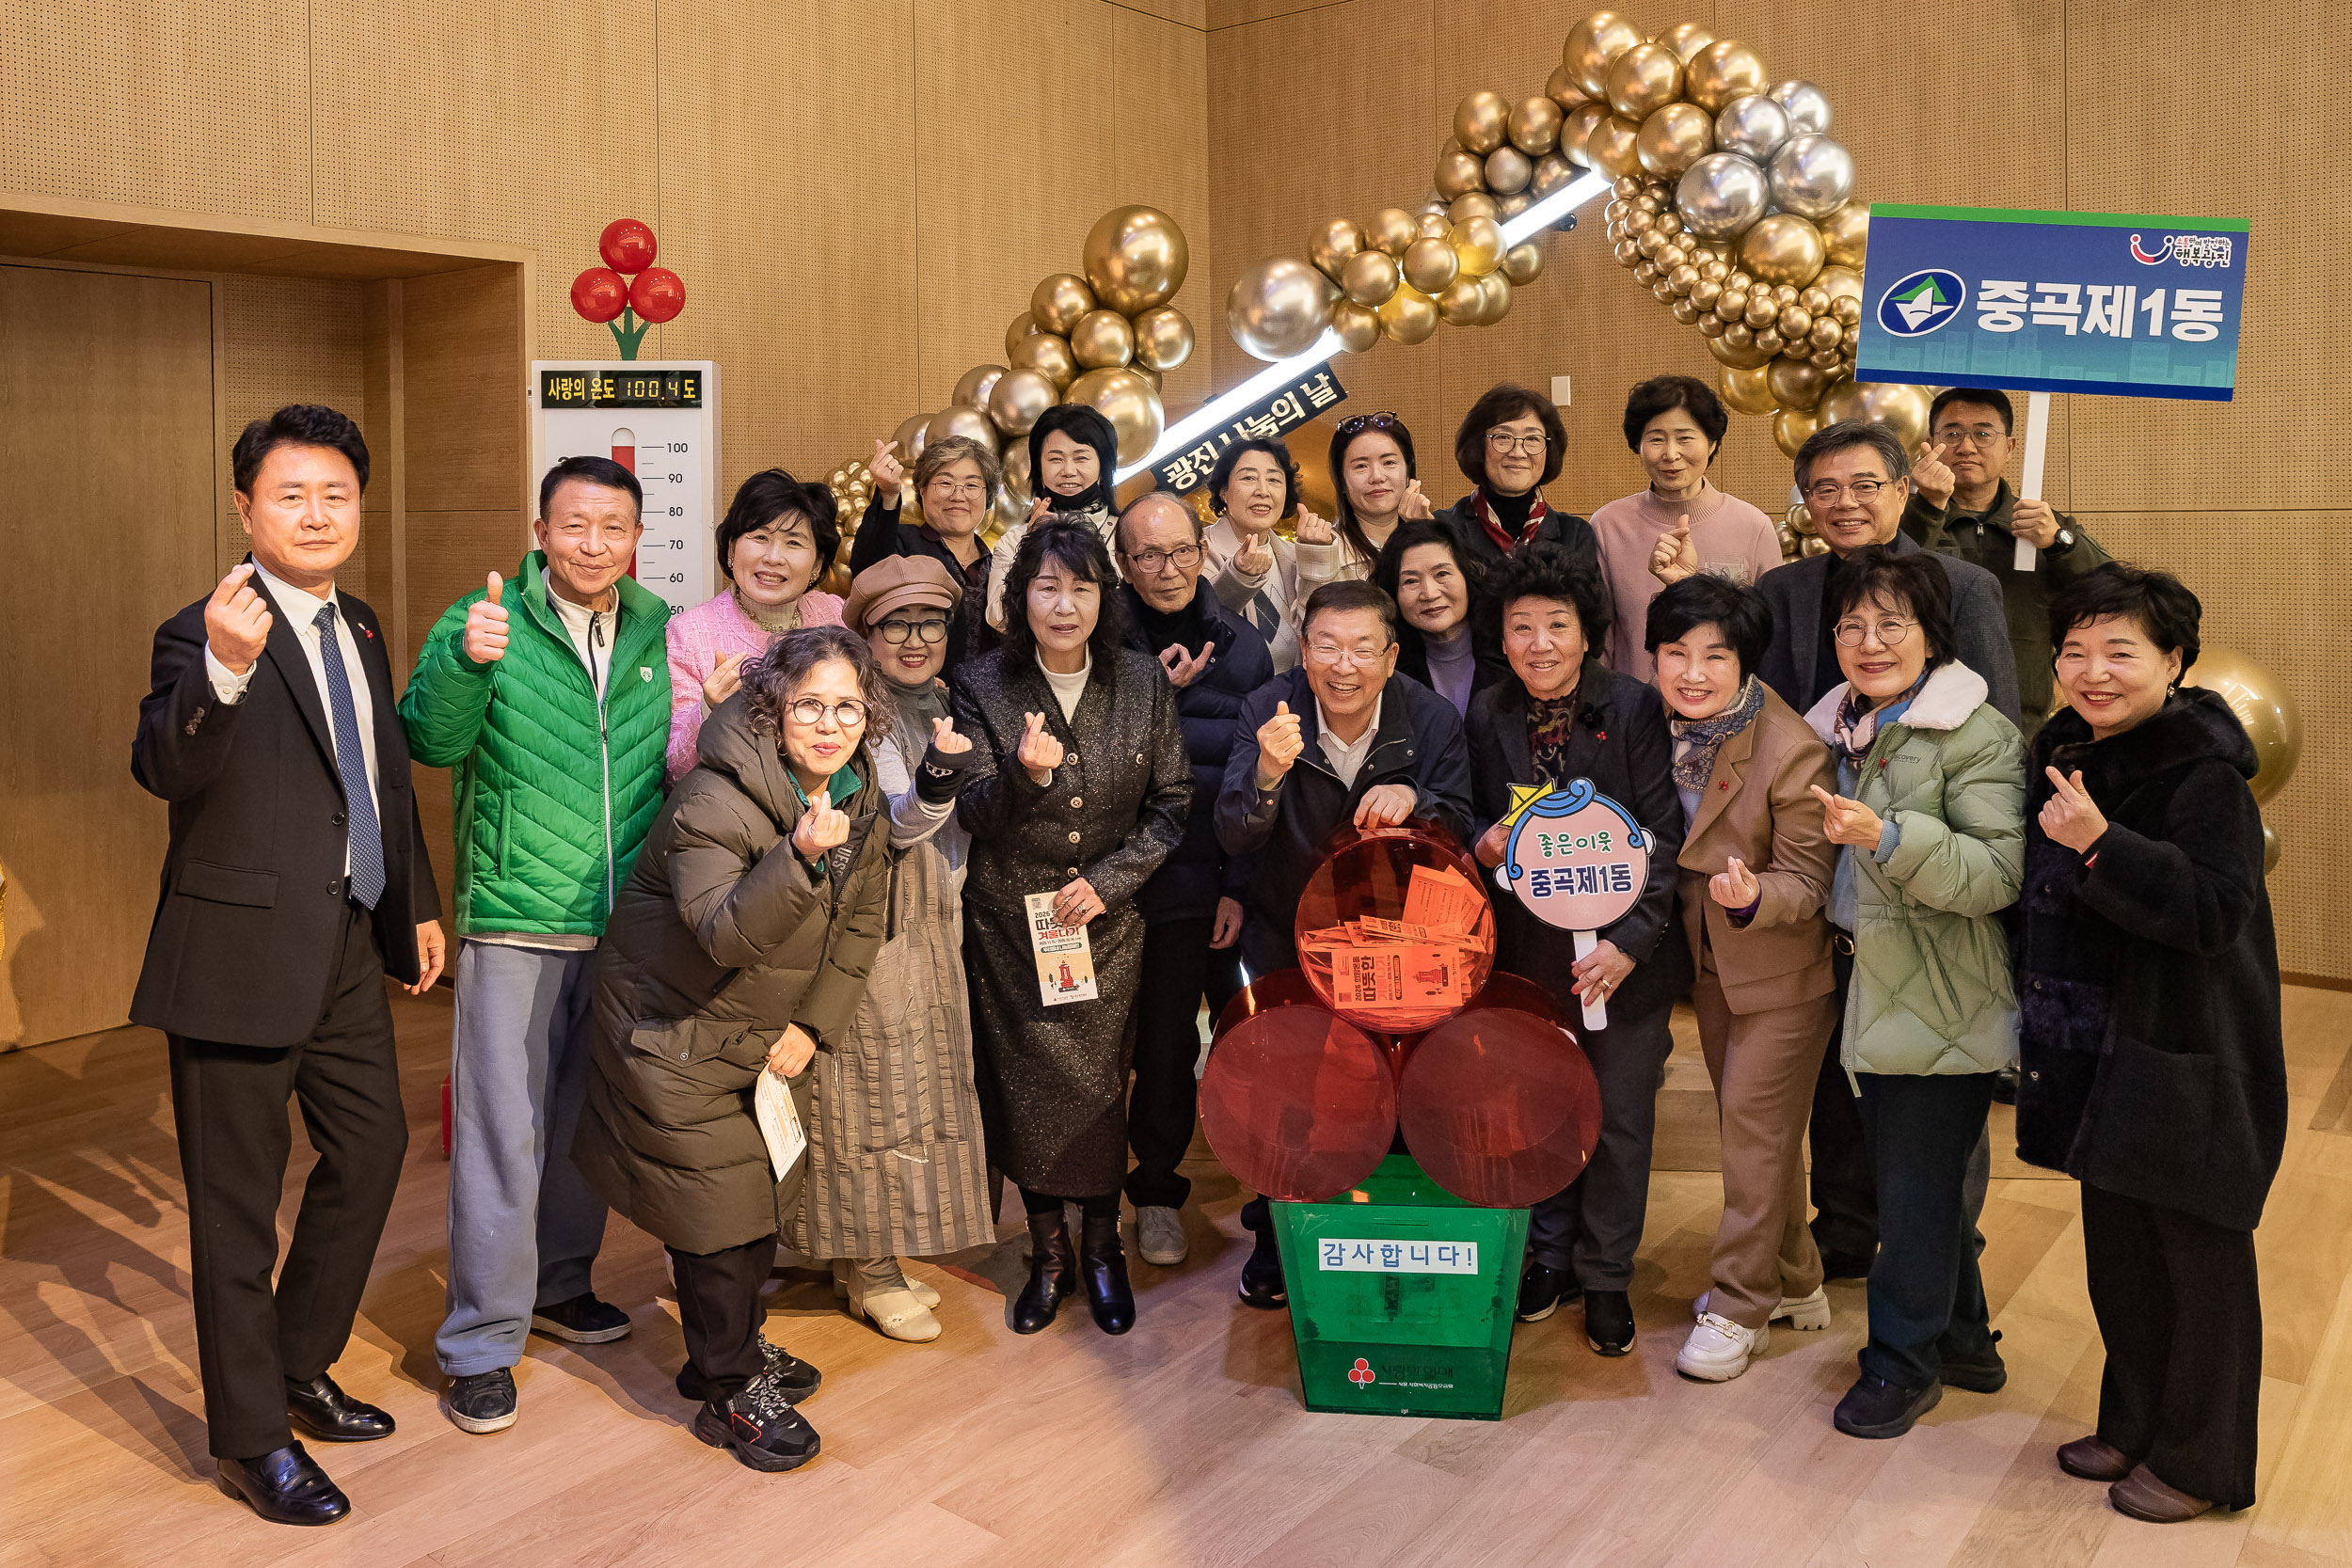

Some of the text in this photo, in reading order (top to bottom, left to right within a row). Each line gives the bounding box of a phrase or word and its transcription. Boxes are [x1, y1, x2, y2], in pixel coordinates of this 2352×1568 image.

[2175, 237, 2202, 247] 소통하며
[2175, 247, 2230, 266] 행복광진
[1977, 279, 2224, 342] 중곡제1동
[548, 376, 696, 401] 사랑의 온도 100.4 도
[1162, 439, 1219, 490] 광진
[1299, 372, 1338, 409] 날
[666, 442, 689, 453] 100
[668, 473, 683, 483] 90
[669, 507, 684, 517] 80
[669, 540, 684, 550] 70
[669, 573, 684, 583] 60
[670, 605, 685, 616] 50
[1536, 831, 1613, 858] 좋은이웃
[1530, 863, 1633, 898] 중곡제1동
[1035, 911, 1051, 919] 2026
[1360, 955, 1376, 1002] 따뜻한
[1323, 1242, 1473, 1268] 감사합니다!
